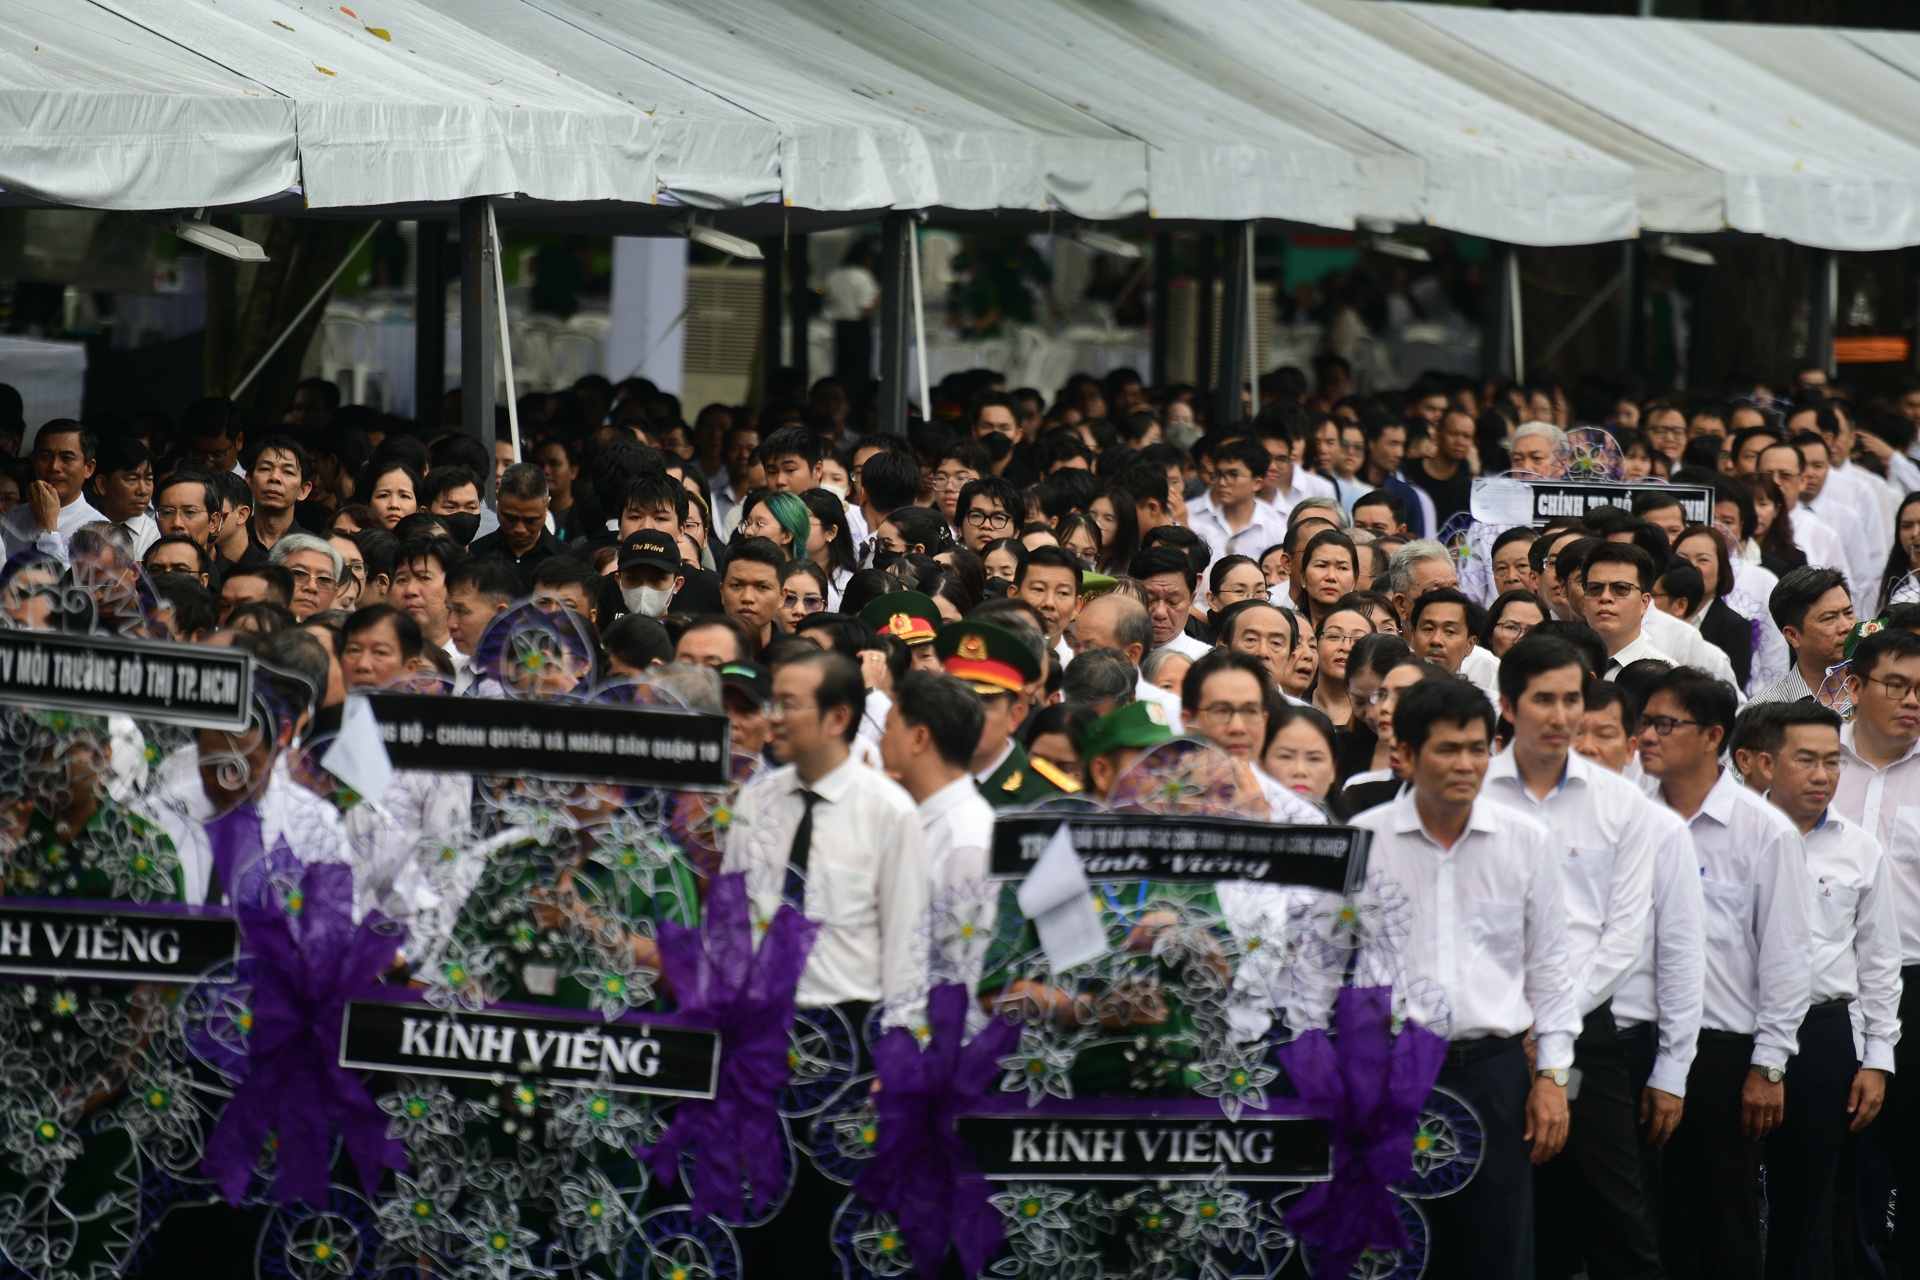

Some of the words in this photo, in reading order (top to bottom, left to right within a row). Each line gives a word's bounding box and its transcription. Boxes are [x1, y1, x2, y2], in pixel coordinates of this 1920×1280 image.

[1537, 489, 1584, 517] CHÍNH
[632, 543, 643, 551] The
[643, 542, 664, 552] Weird
[42, 914, 181, 965] VIẾNG
[400, 1012, 516, 1064] KÍNH
[523, 1024, 661, 1078] VIẾNG
[1009, 1122, 1126, 1163] KÍNH
[1134, 1122, 1274, 1165] VIẾNG
